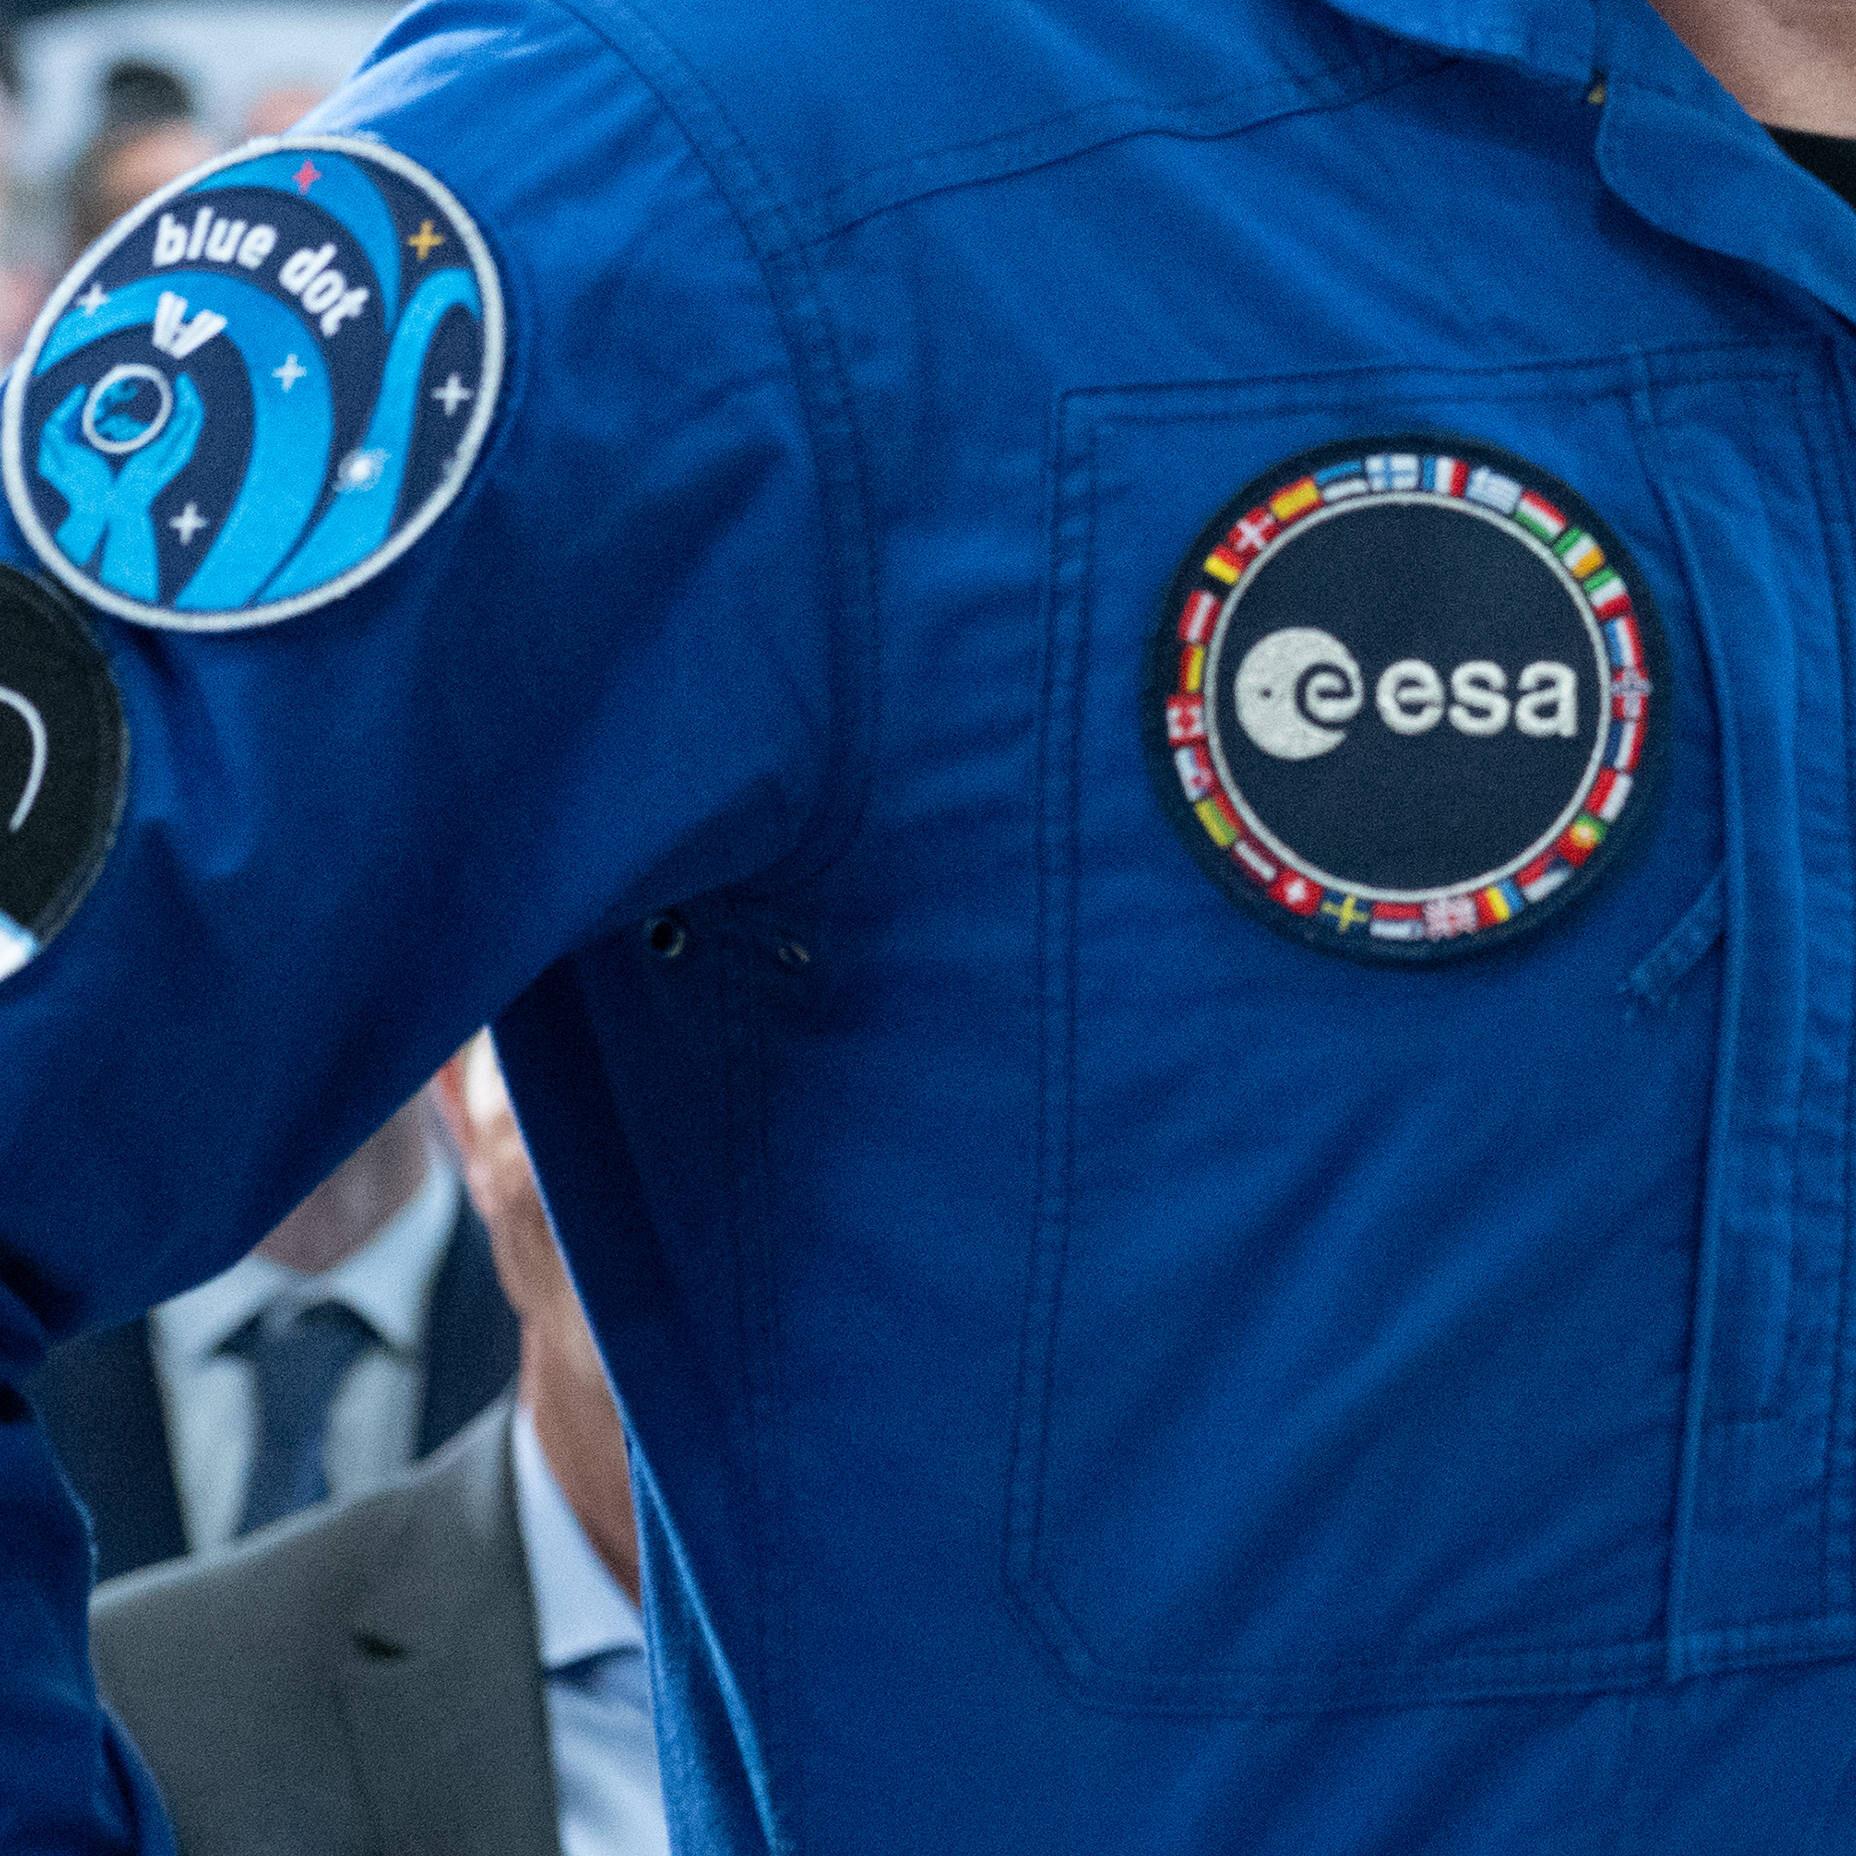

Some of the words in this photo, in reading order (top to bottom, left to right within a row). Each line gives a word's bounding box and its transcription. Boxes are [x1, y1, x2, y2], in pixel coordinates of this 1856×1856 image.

[153, 206, 278, 270] blue
[278, 242, 370, 338] dot
[1375, 658, 1578, 739] esa
